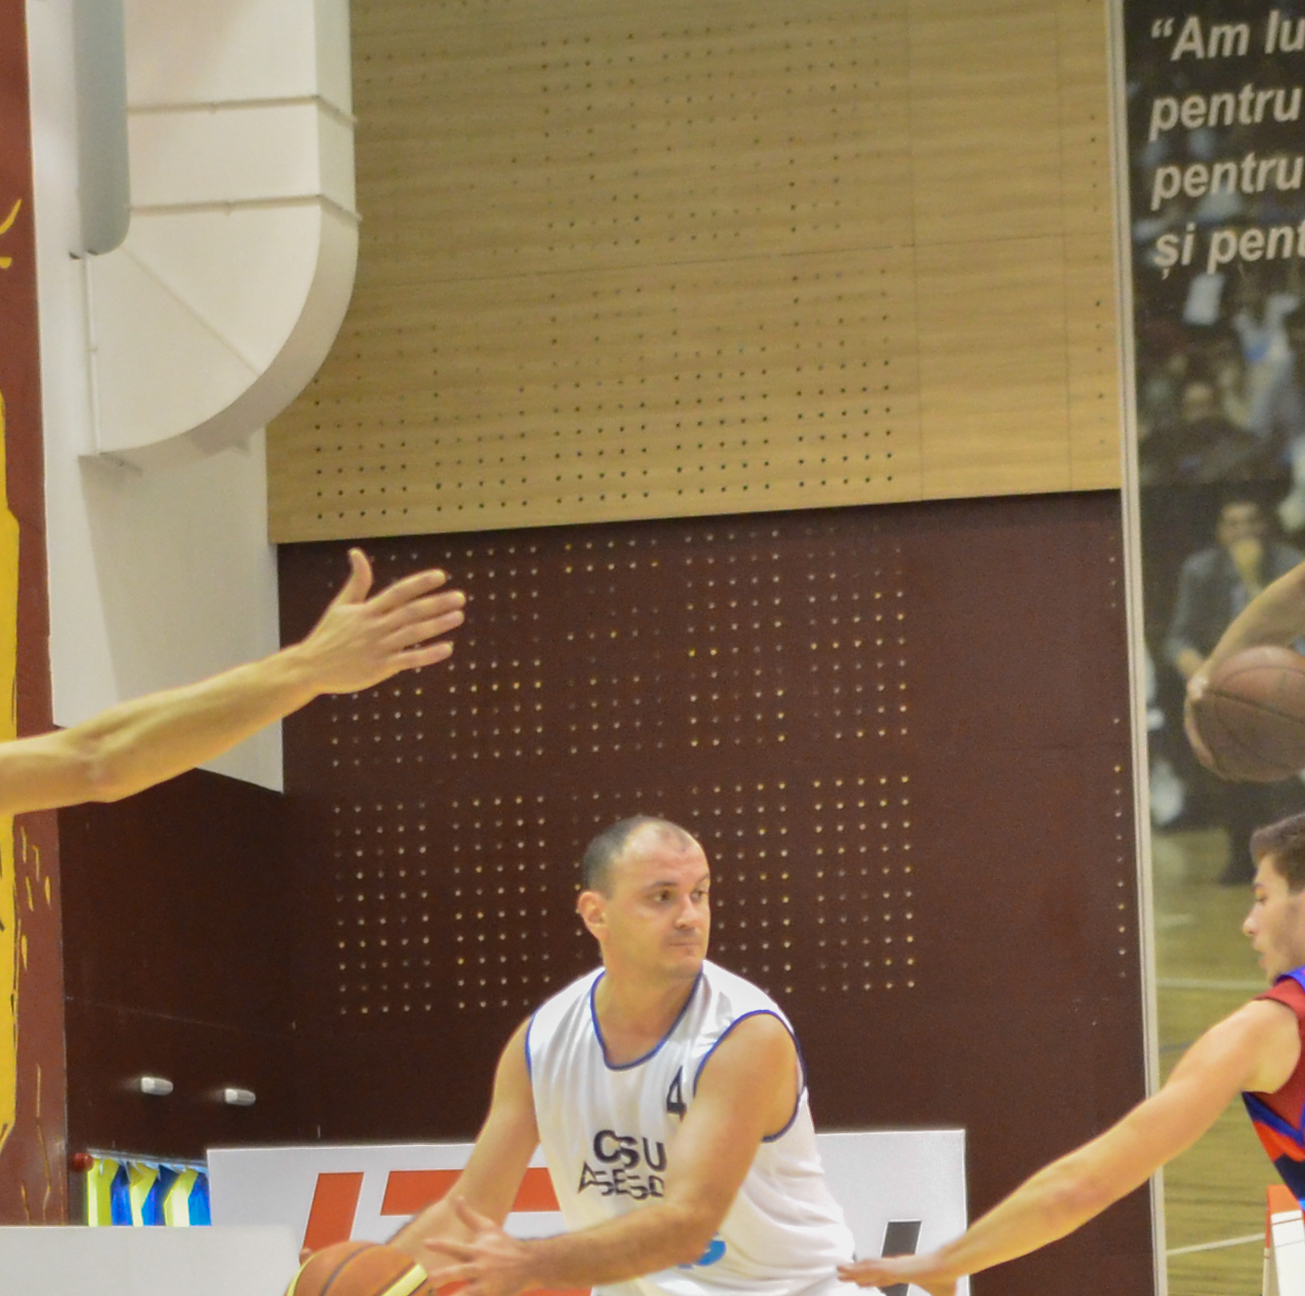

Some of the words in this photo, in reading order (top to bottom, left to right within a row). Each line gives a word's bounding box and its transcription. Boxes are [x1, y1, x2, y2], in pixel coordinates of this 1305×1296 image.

[1148, 86, 1301, 141] pentru
[1150, 153, 1302, 210] pentru
[1154, 228, 1193, 280] și
[593, 1130, 667, 1172] CSU
